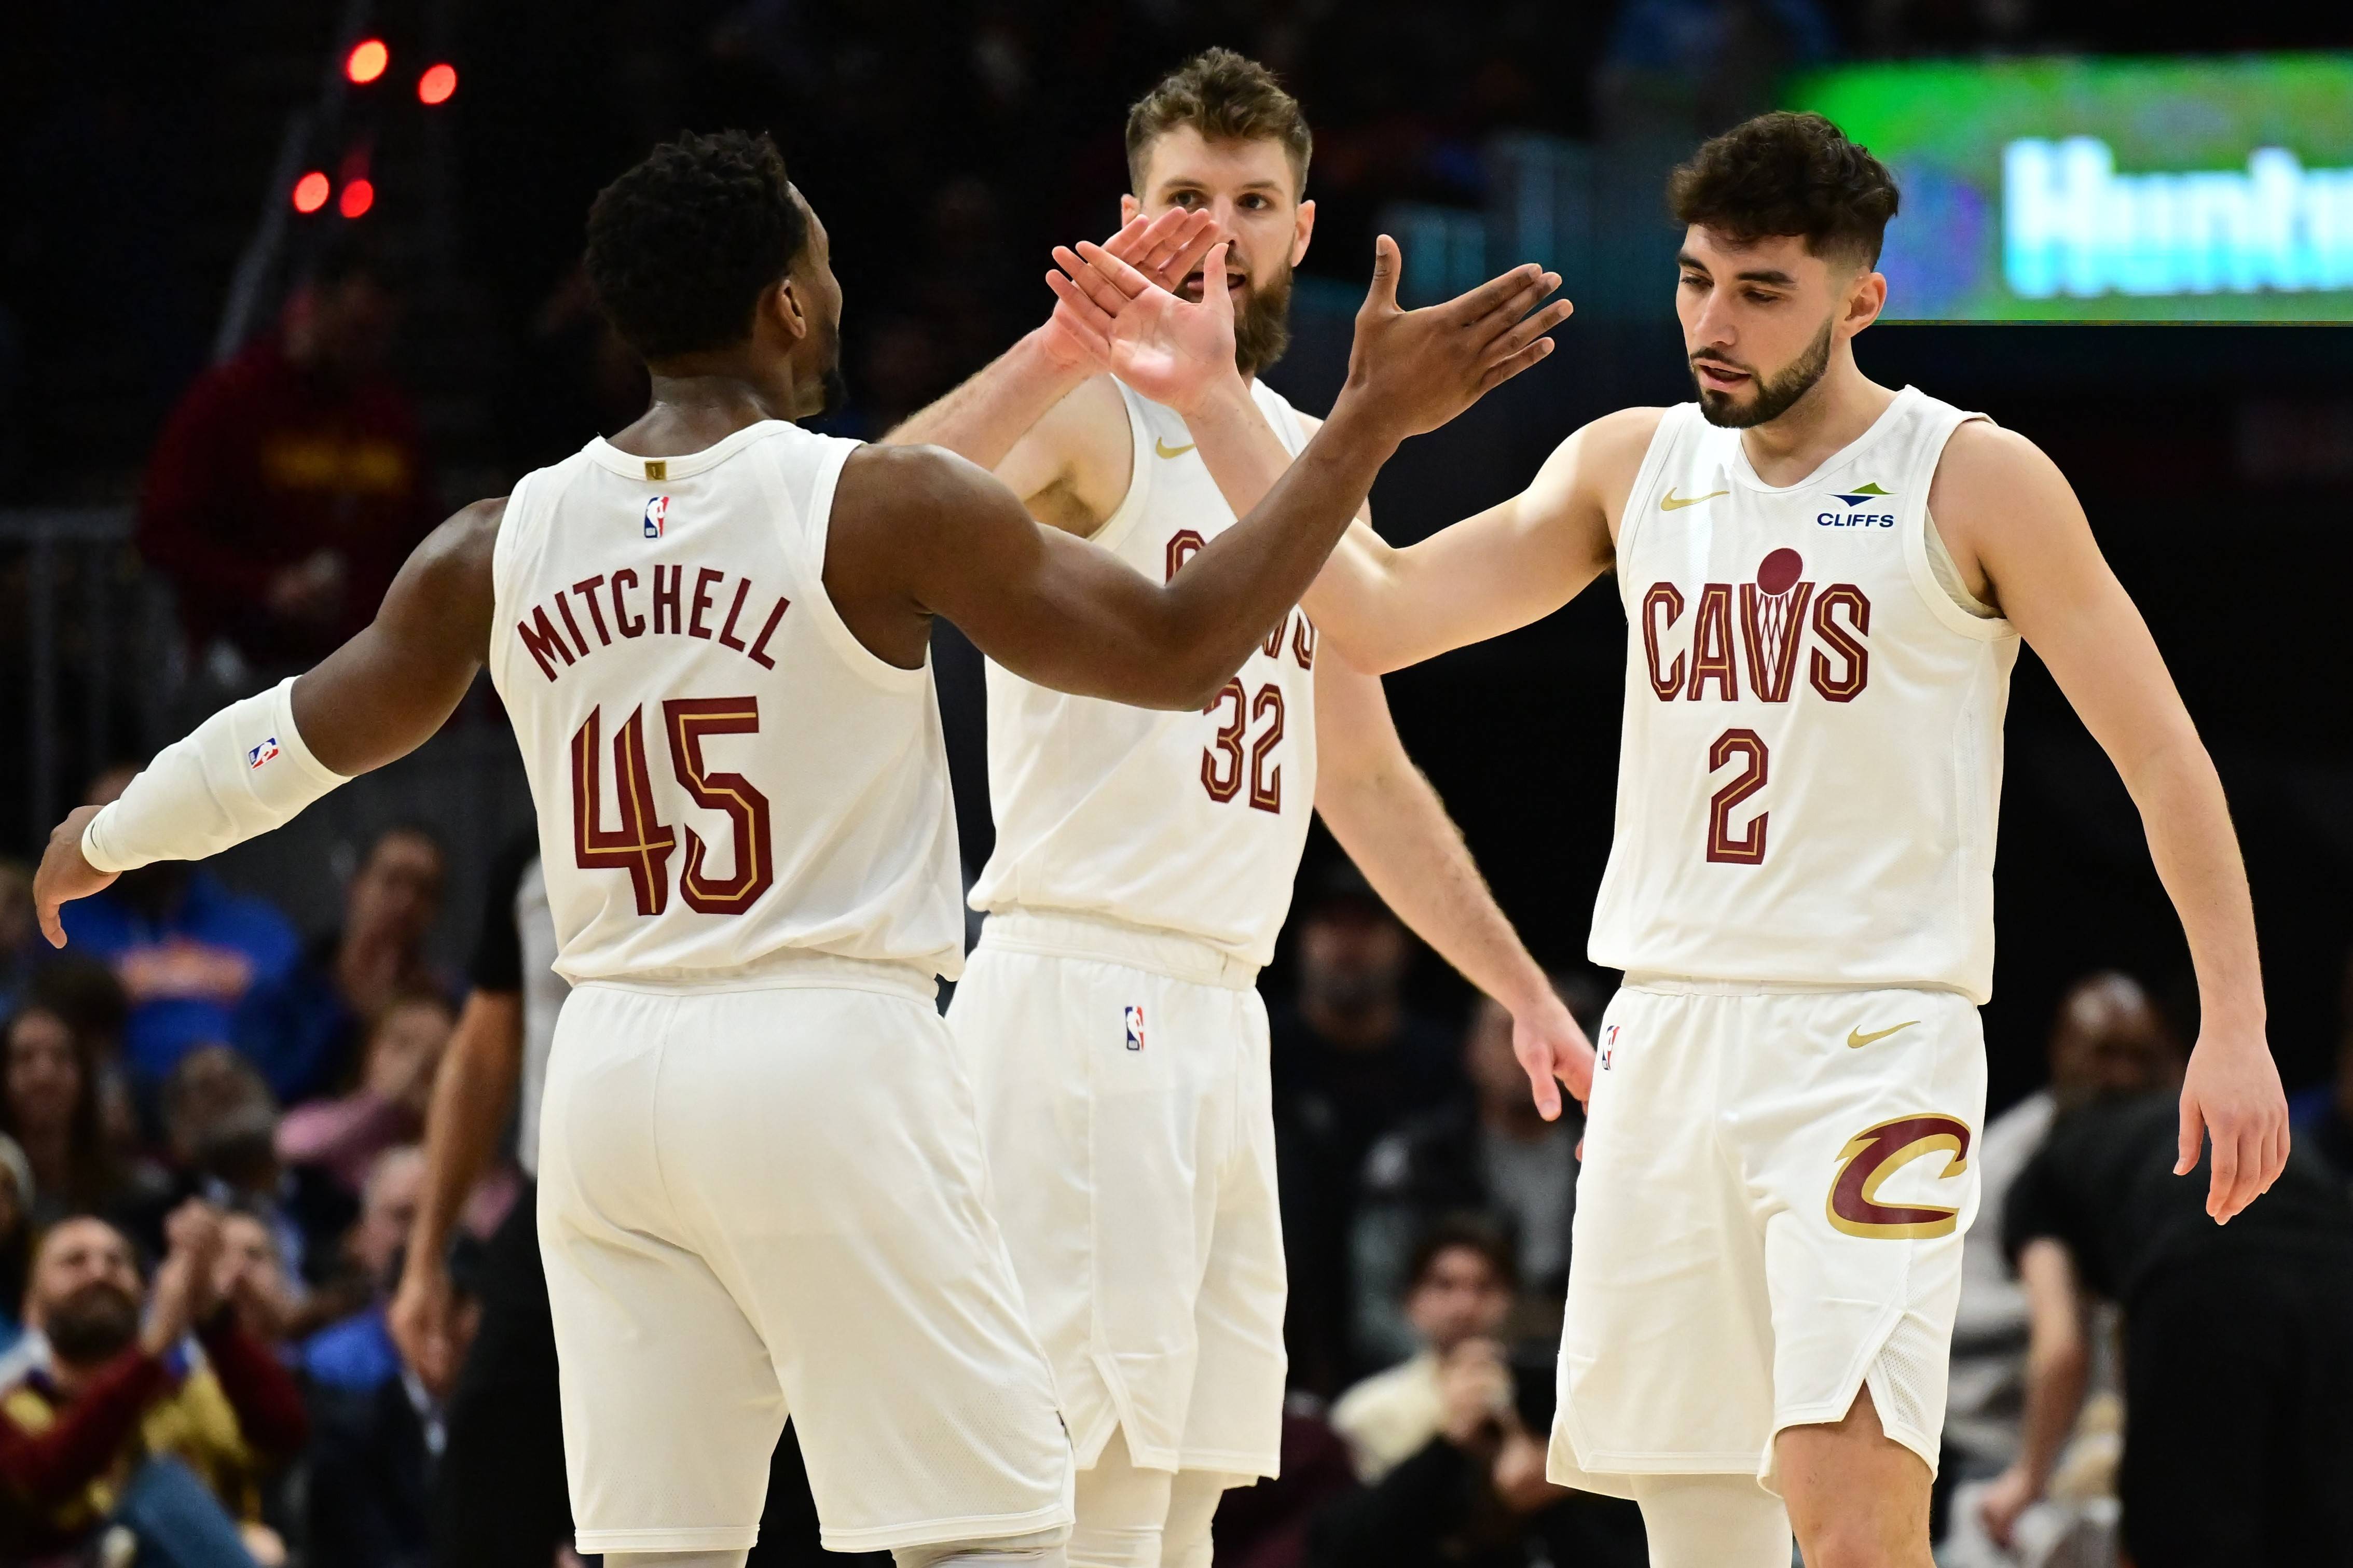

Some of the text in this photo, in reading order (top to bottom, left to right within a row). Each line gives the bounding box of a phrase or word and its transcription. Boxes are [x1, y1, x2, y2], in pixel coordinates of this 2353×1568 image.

[1817, 512, 1894, 528] CLIFFS
[518, 565, 790, 682] MITCHELL
[1643, 581, 1870, 703] CAVS
[571, 696, 774, 916] 45
[1201, 677, 1285, 814] 32
[1707, 728, 1769, 865] 2
[1826, 1112, 1972, 1240] C
